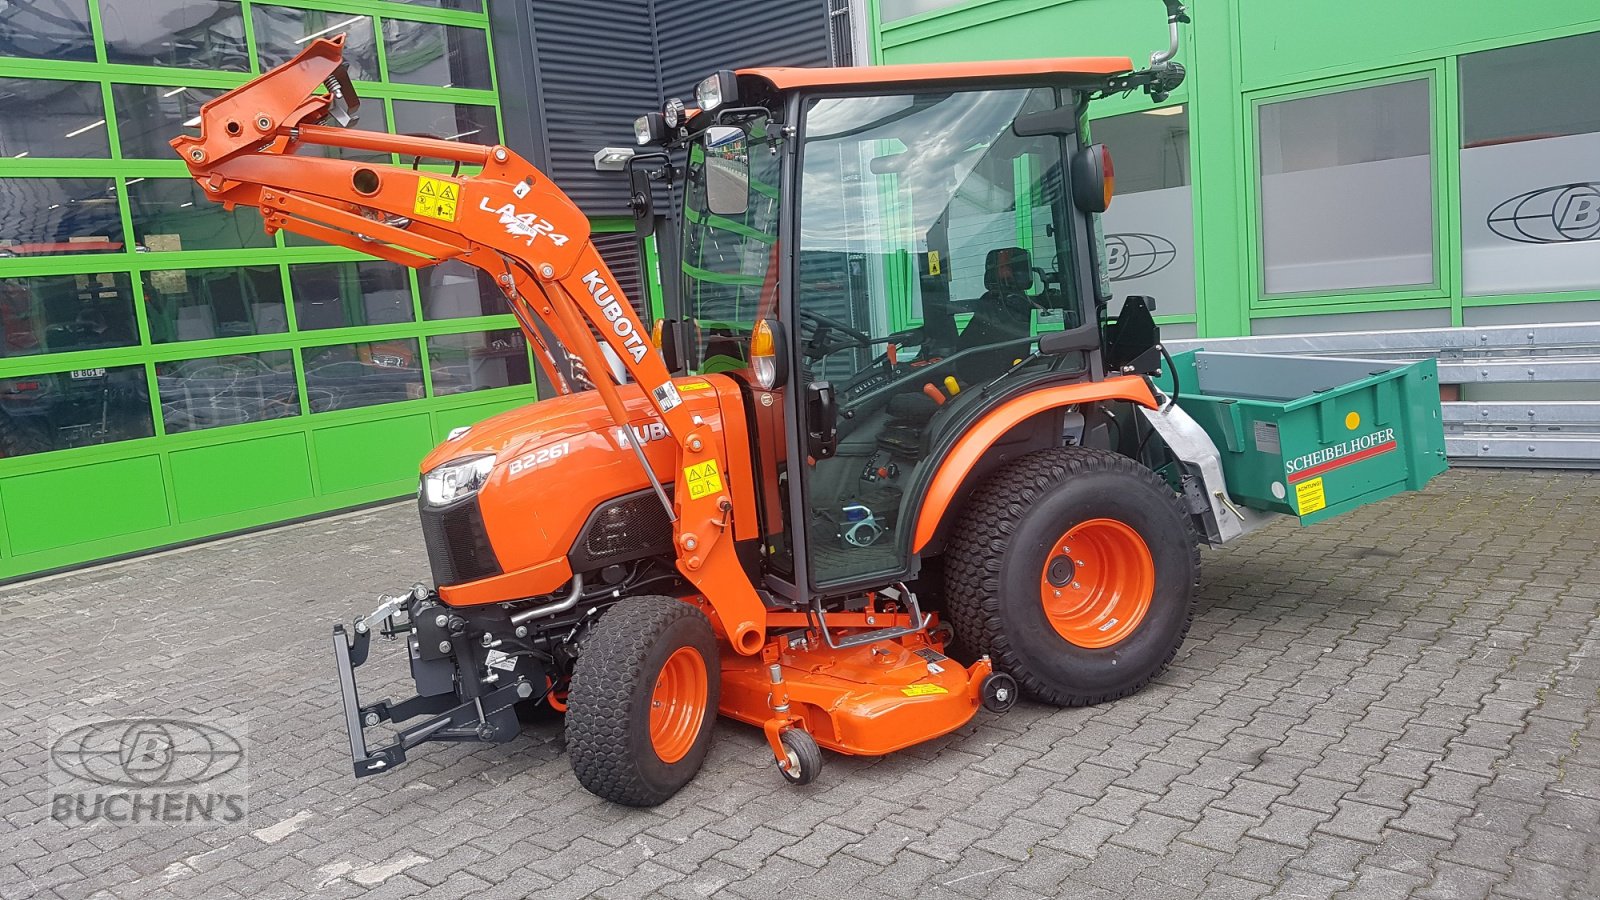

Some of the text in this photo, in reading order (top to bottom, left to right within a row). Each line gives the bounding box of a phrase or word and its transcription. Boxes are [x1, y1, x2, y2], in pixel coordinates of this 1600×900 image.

[479, 196, 570, 247] LA424
[581, 269, 648, 365] KUBOTA
[509, 442, 571, 475] B2261
[1286, 428, 1395, 474] SCHEIBELHOFER
